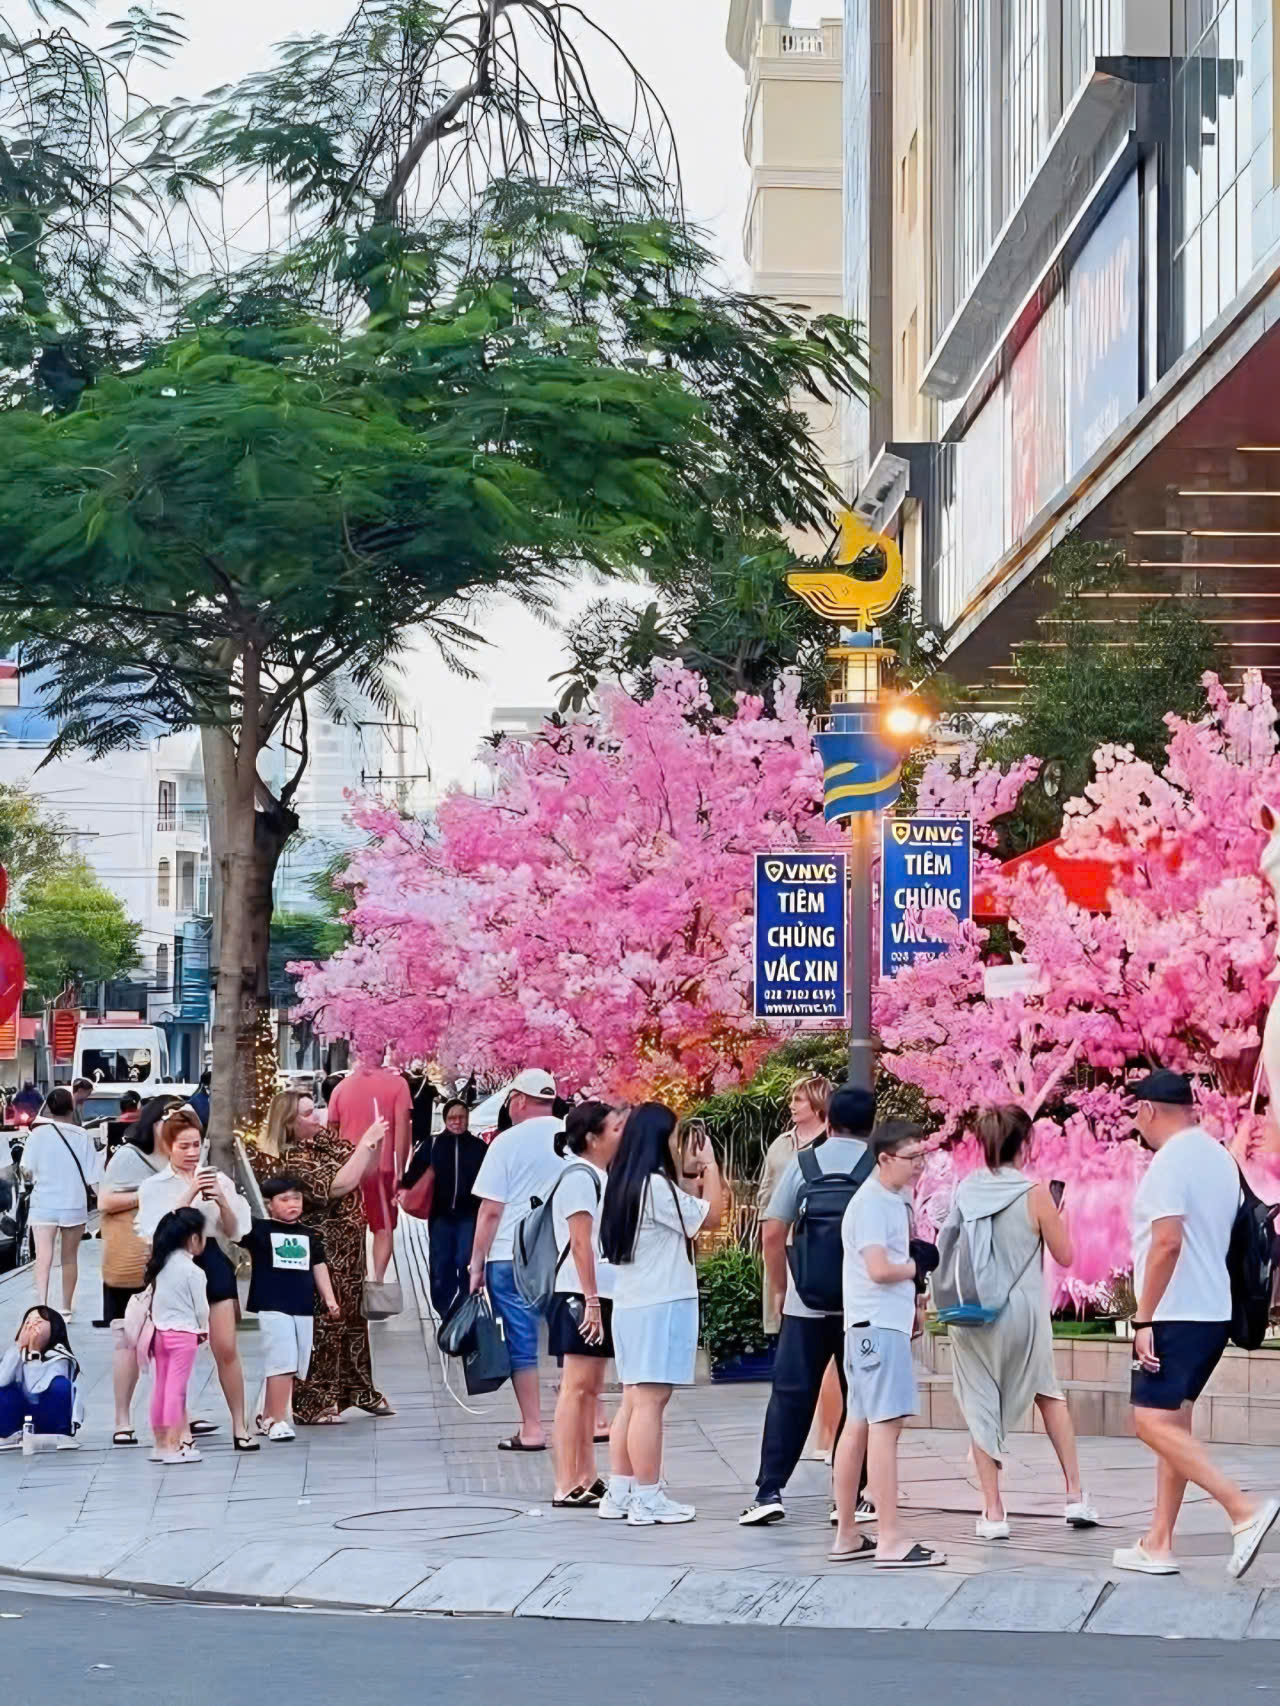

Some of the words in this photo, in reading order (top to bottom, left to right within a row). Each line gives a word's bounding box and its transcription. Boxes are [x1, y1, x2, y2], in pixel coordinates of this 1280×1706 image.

[912, 826, 963, 842] VNVC
[785, 864, 837, 881] VNVC
[904, 851, 951, 875] TIÊM
[777, 889, 824, 912] TIÊM
[768, 921, 835, 947] CHỦNG
[764, 954, 801, 982] VÁC
[804, 960, 838, 982] XIN
